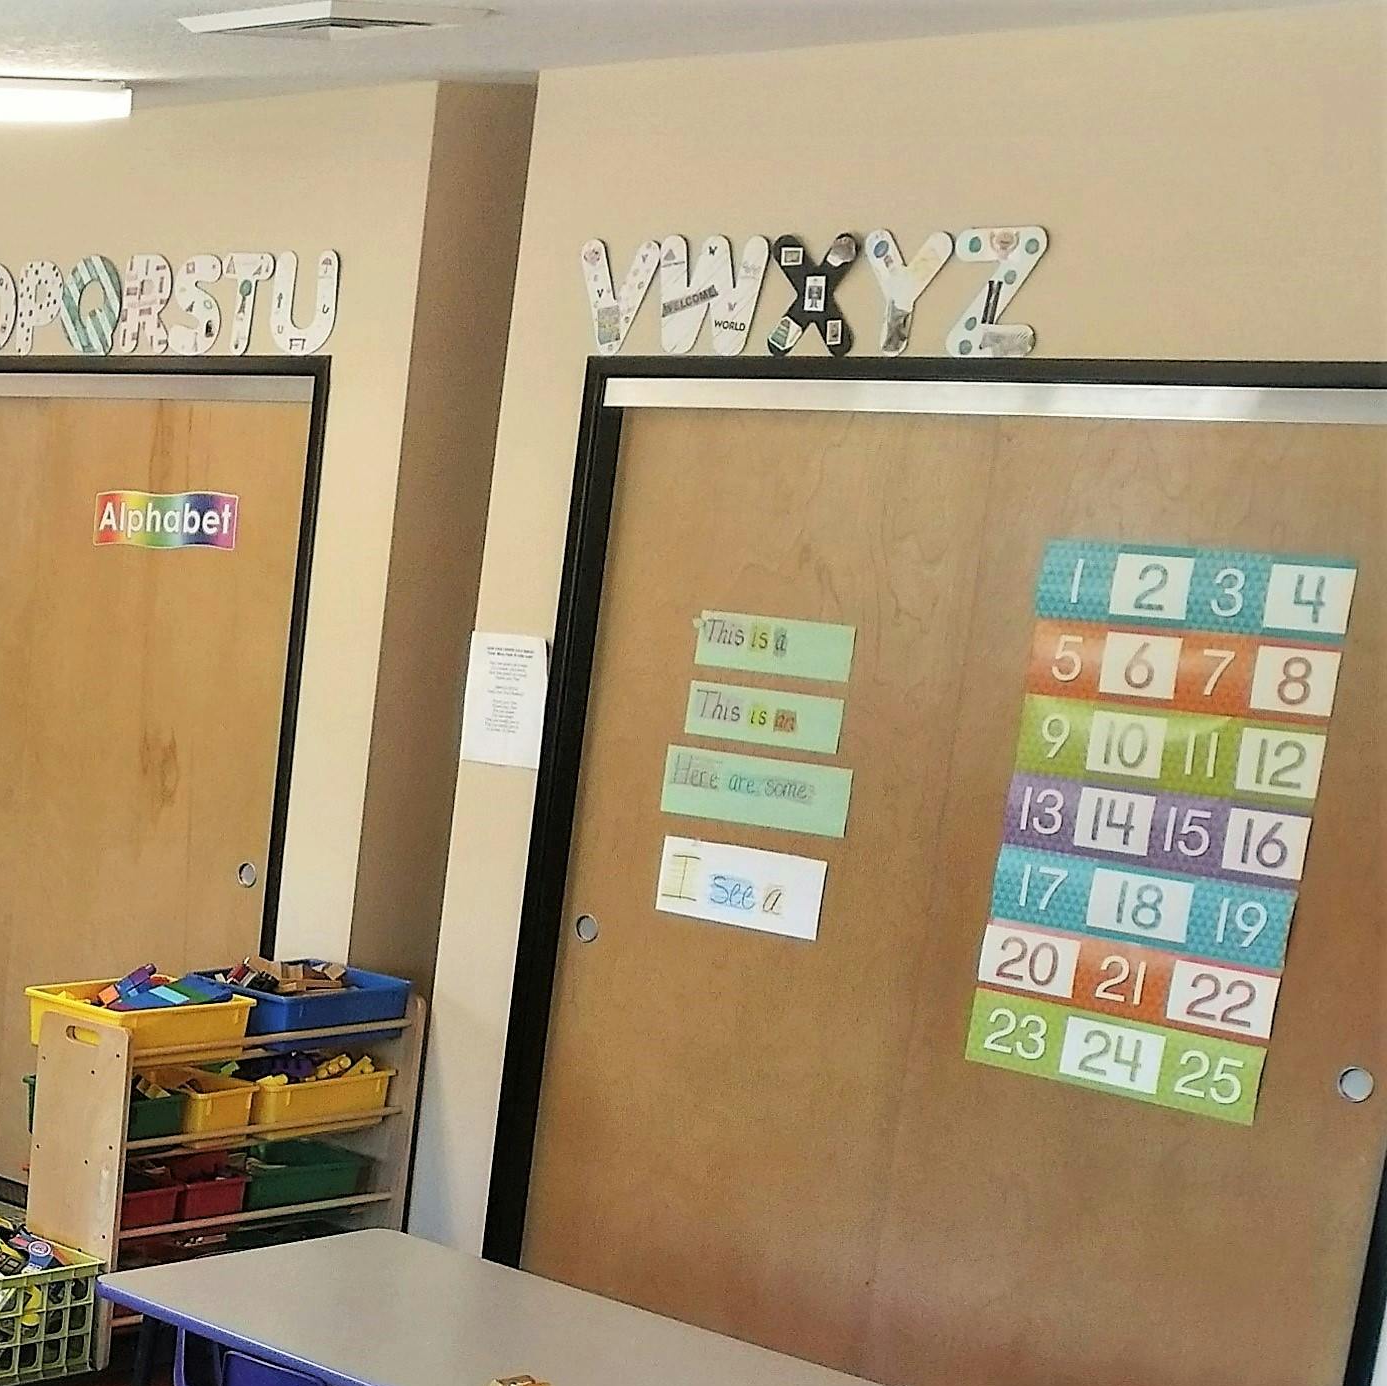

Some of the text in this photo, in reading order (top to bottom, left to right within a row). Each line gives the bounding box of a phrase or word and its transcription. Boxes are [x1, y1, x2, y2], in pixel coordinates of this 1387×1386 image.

[714, 320, 746, 331] WORLD
[98, 502, 233, 540] Alphabet
[1069, 557, 1326, 624] 1 2 3 4
[705, 617, 788, 653] This is a
[1050, 634, 1312, 706] 5 6 7 8
[697, 688, 798, 733] This is an
[673, 753, 720, 791] Here
[728, 773, 756, 794] are
[1040, 713, 1305, 790] 9 10 11 12
[1019, 786, 1287, 870] 13 14 15 16
[661, 854, 701, 902] I
[762, 888, 783, 915] a
[1018, 864, 1269, 949] 17 18 19
[995, 936, 1256, 1029] 20 21 22
[983, 1007, 1244, 1105] 23 24 25
